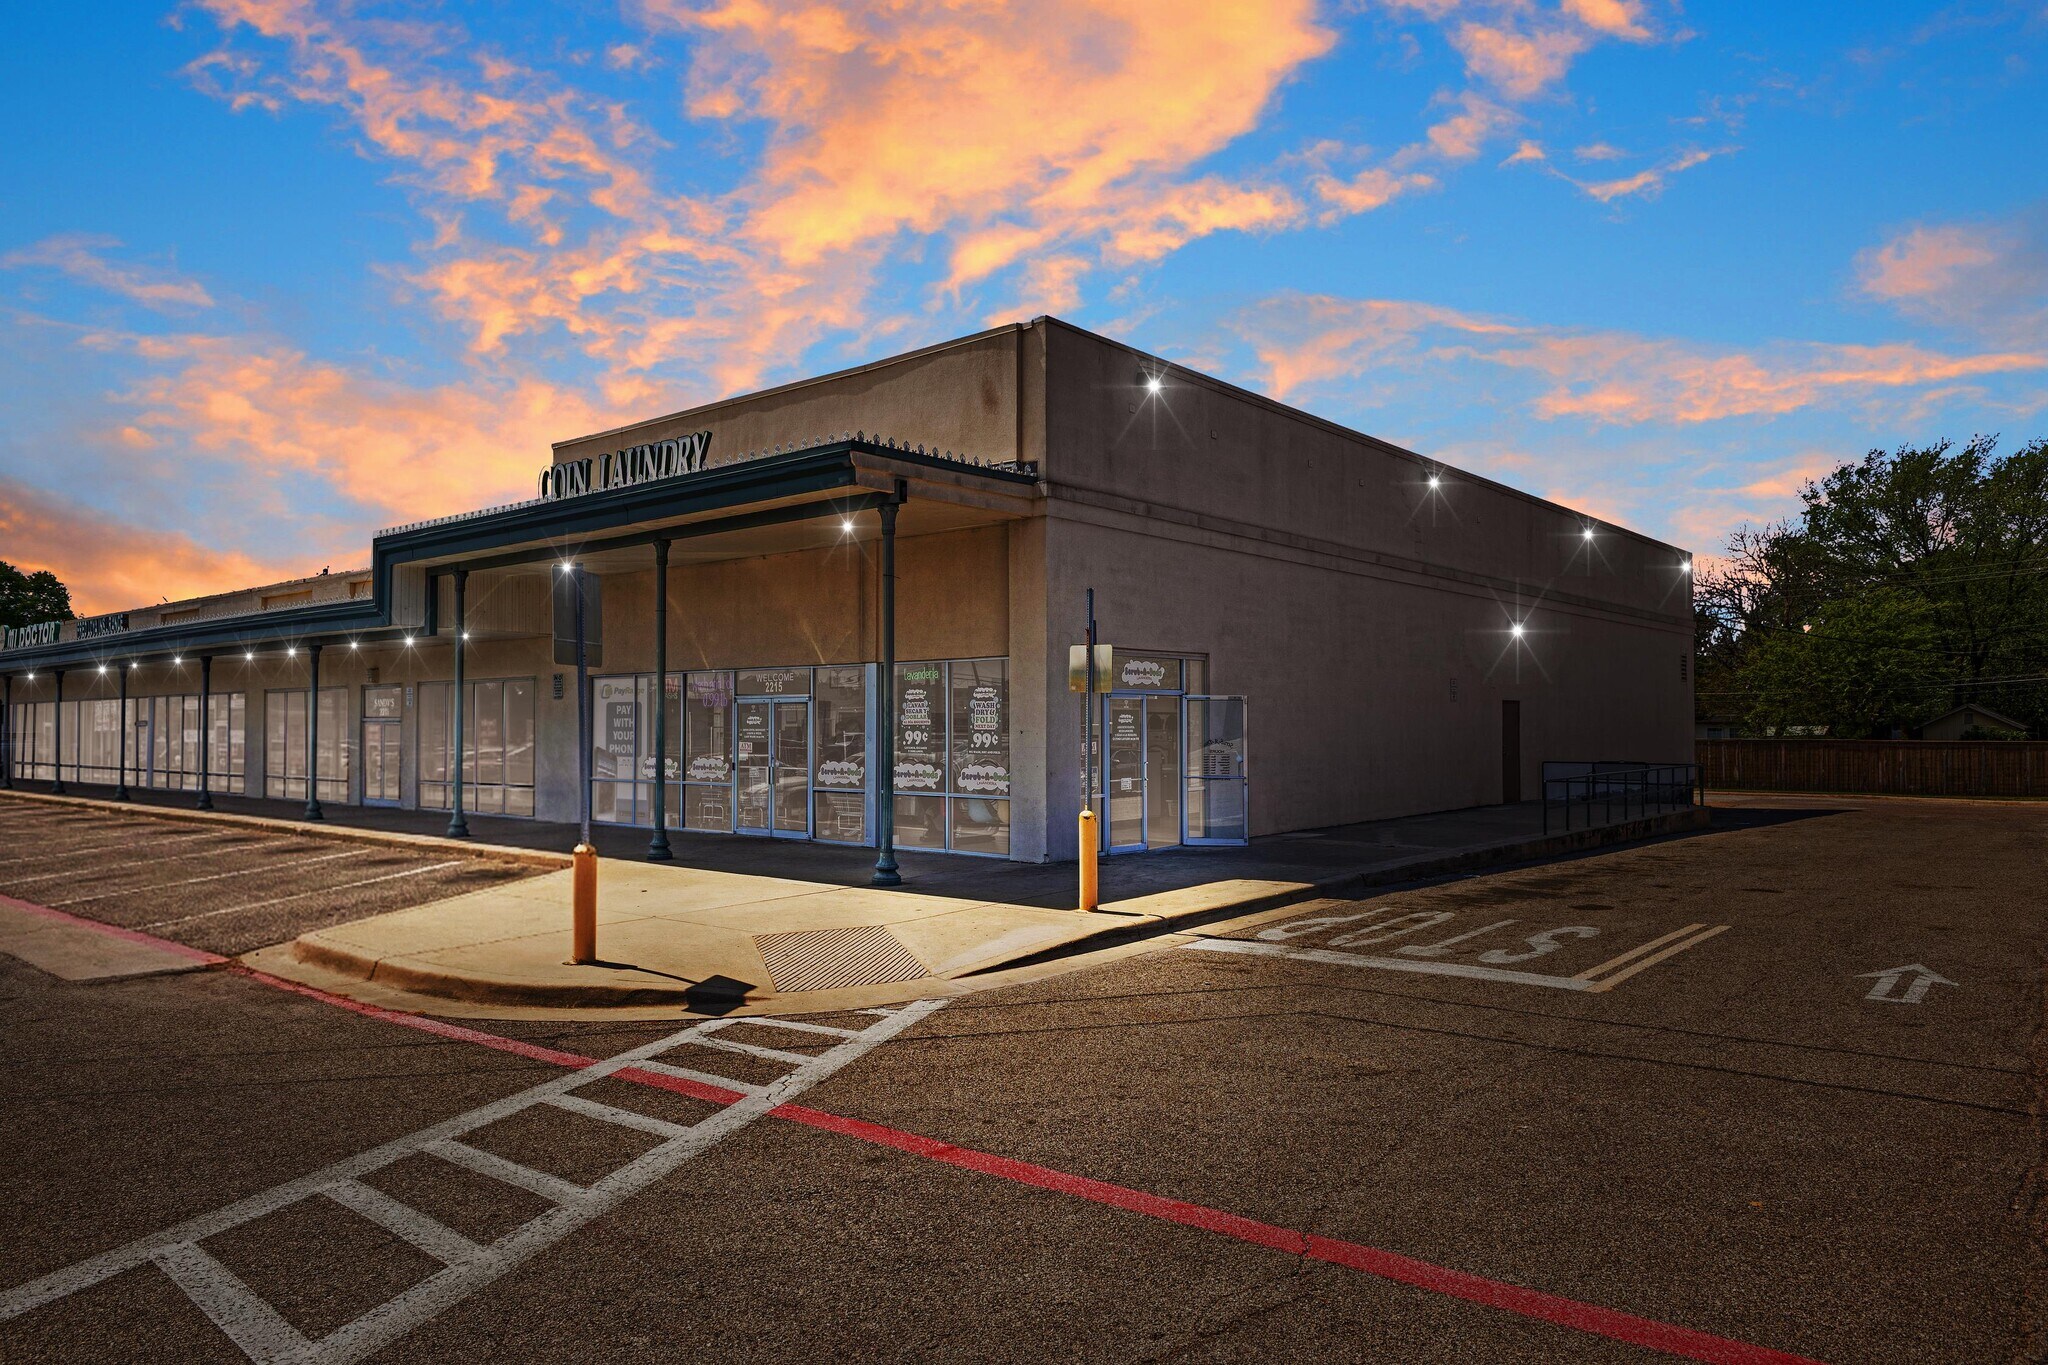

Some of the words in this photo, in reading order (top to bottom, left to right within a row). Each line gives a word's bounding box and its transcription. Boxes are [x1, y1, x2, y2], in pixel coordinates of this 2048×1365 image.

[537, 457, 592, 502] COIN
[599, 430, 713, 491] LAUNDRY
[20, 620, 60, 648] DOCTOR
[756, 673, 794, 682] WELCOME
[614, 686, 645, 697] PayRage
[765, 682, 783, 693] 2215
[616, 705, 632, 715] PAY
[613, 718, 634, 727] WITH
[609, 744, 634, 754] PHON
[1256, 907, 1600, 964] STOP
